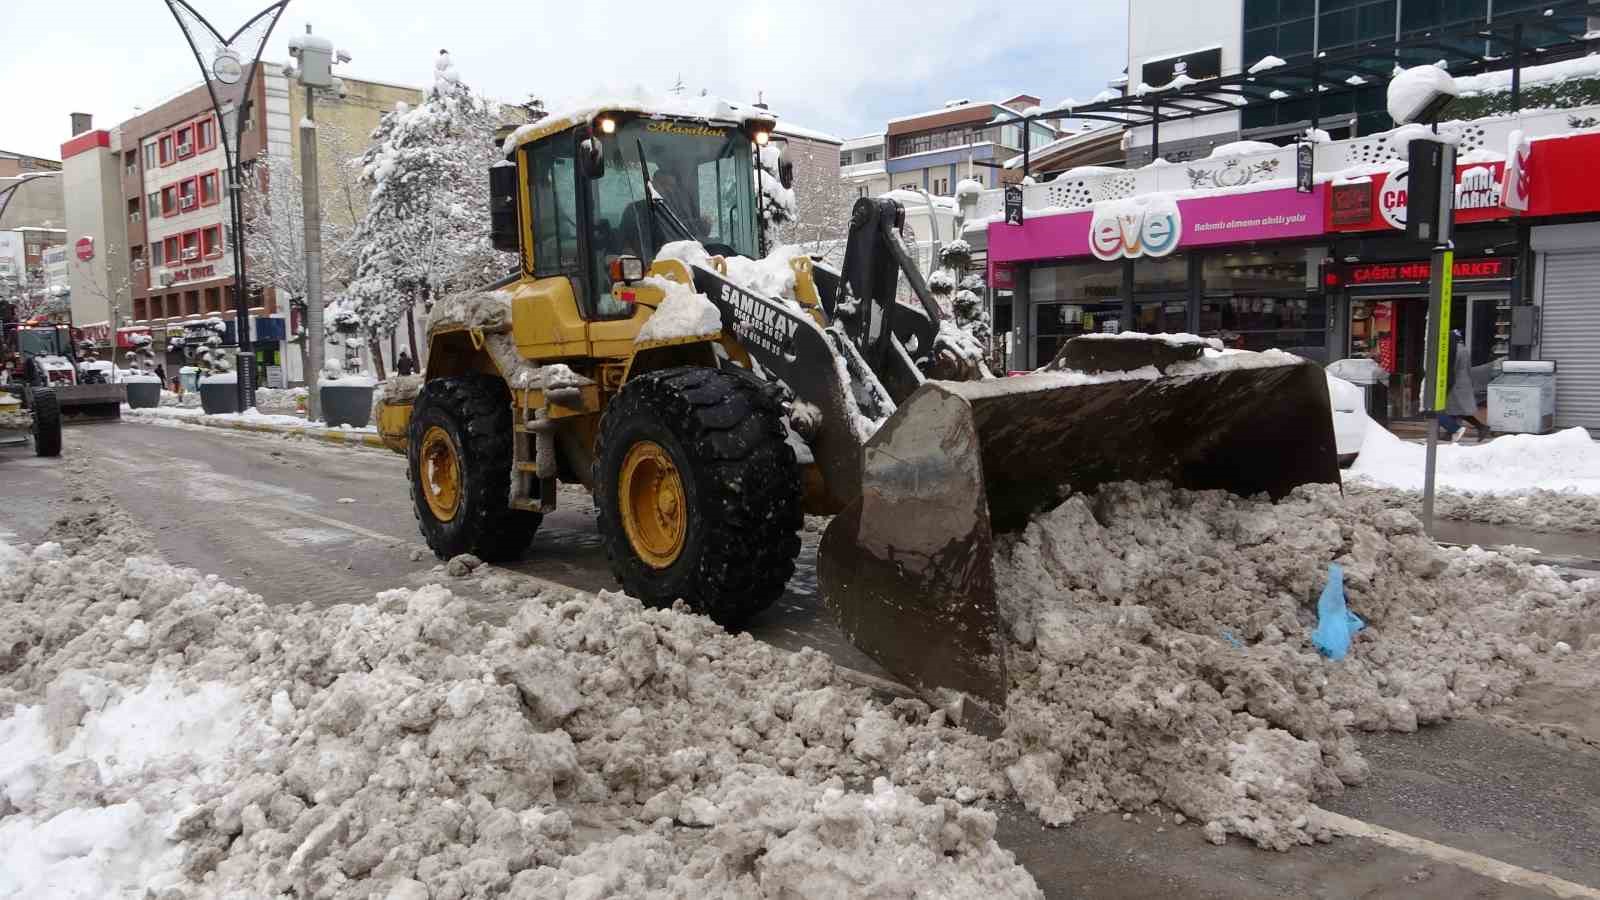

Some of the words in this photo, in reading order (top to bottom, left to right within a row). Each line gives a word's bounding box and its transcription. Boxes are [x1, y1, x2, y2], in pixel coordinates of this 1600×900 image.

[1093, 211, 1176, 254] eve
[1400, 263, 1431, 277] MİN
[1453, 262, 1501, 276] ARKET
[721, 284, 799, 338] SAMUKAY
